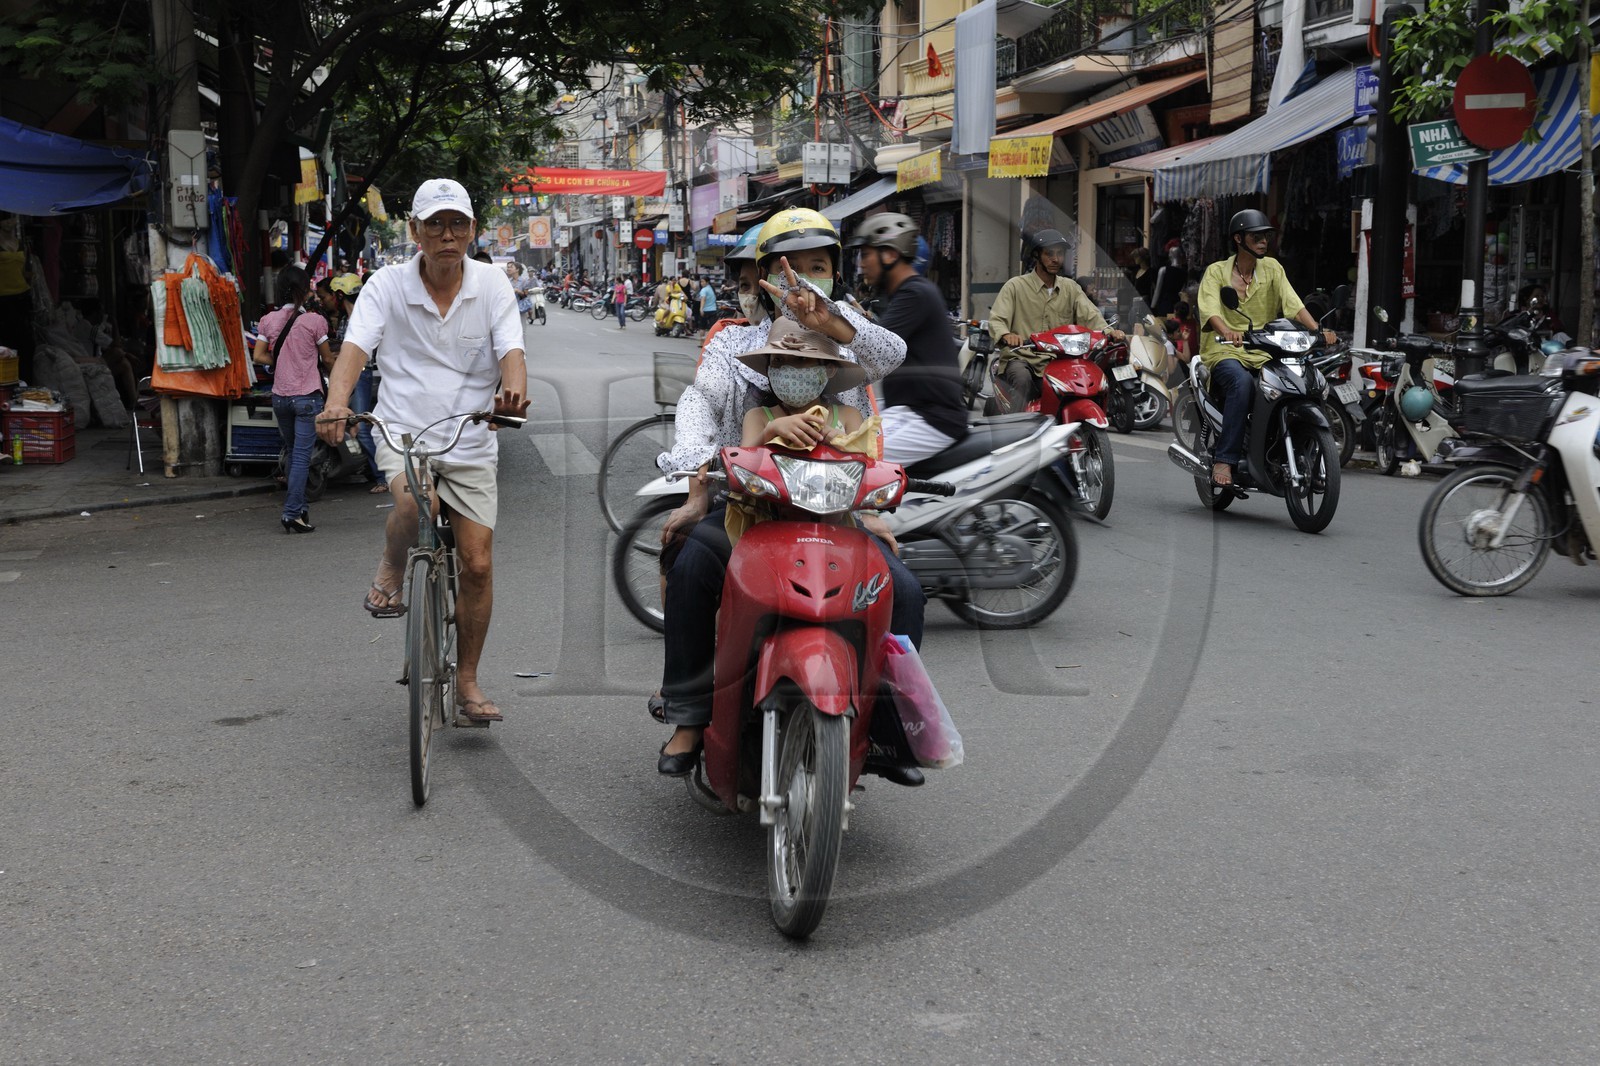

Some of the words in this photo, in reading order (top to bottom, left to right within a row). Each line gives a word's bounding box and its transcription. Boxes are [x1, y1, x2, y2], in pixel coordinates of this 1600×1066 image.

[1418, 124, 1452, 144] NHÀ
[1424, 140, 1468, 152] TOILE
[567, 178, 582, 186] CON
[796, 537, 835, 546] HONDA
